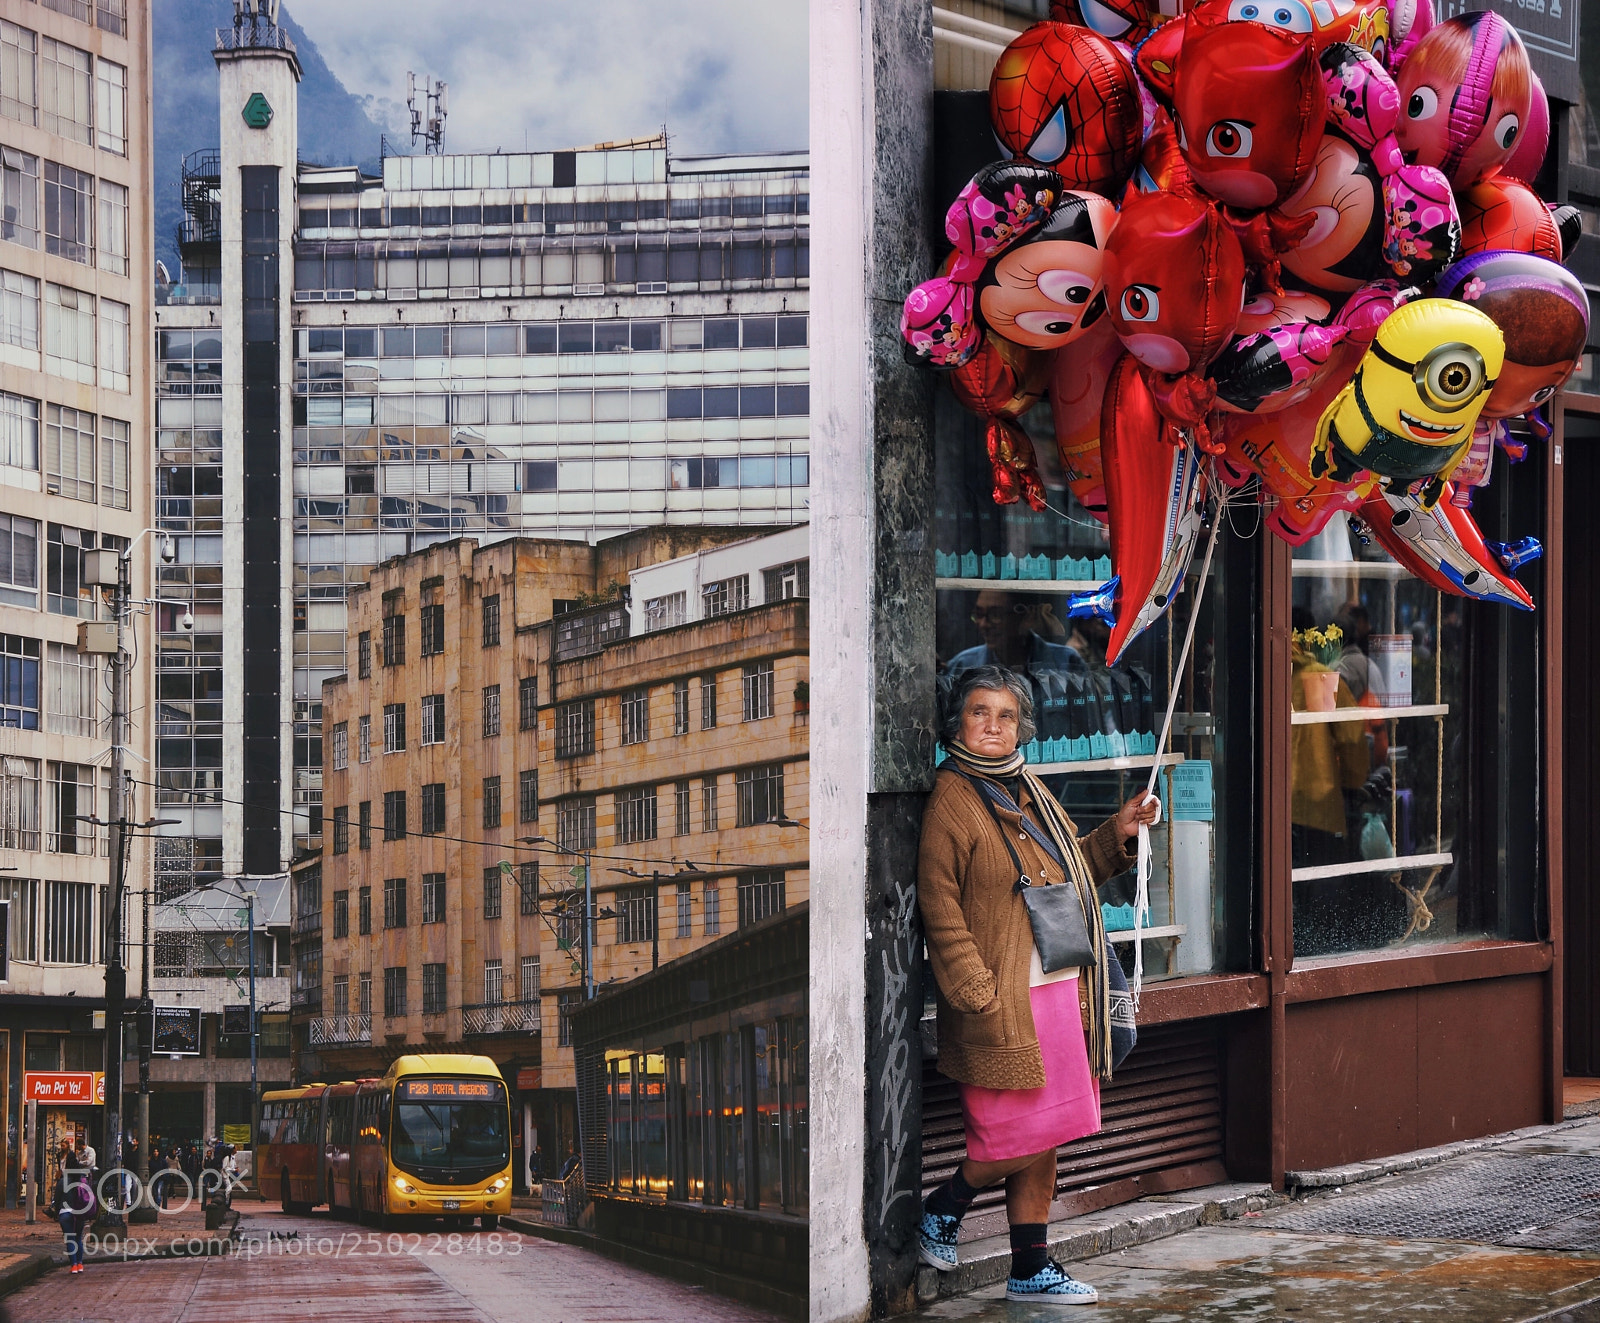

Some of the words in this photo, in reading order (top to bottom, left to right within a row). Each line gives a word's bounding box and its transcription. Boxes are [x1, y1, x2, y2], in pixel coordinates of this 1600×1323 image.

[34, 1081, 51, 1095] Pan
[53, 1081, 67, 1095] Pa'
[68, 1081, 81, 1095] Ya!
[432, 1083, 456, 1095] PORTAL
[458, 1084, 488, 1096] AMERICAS
